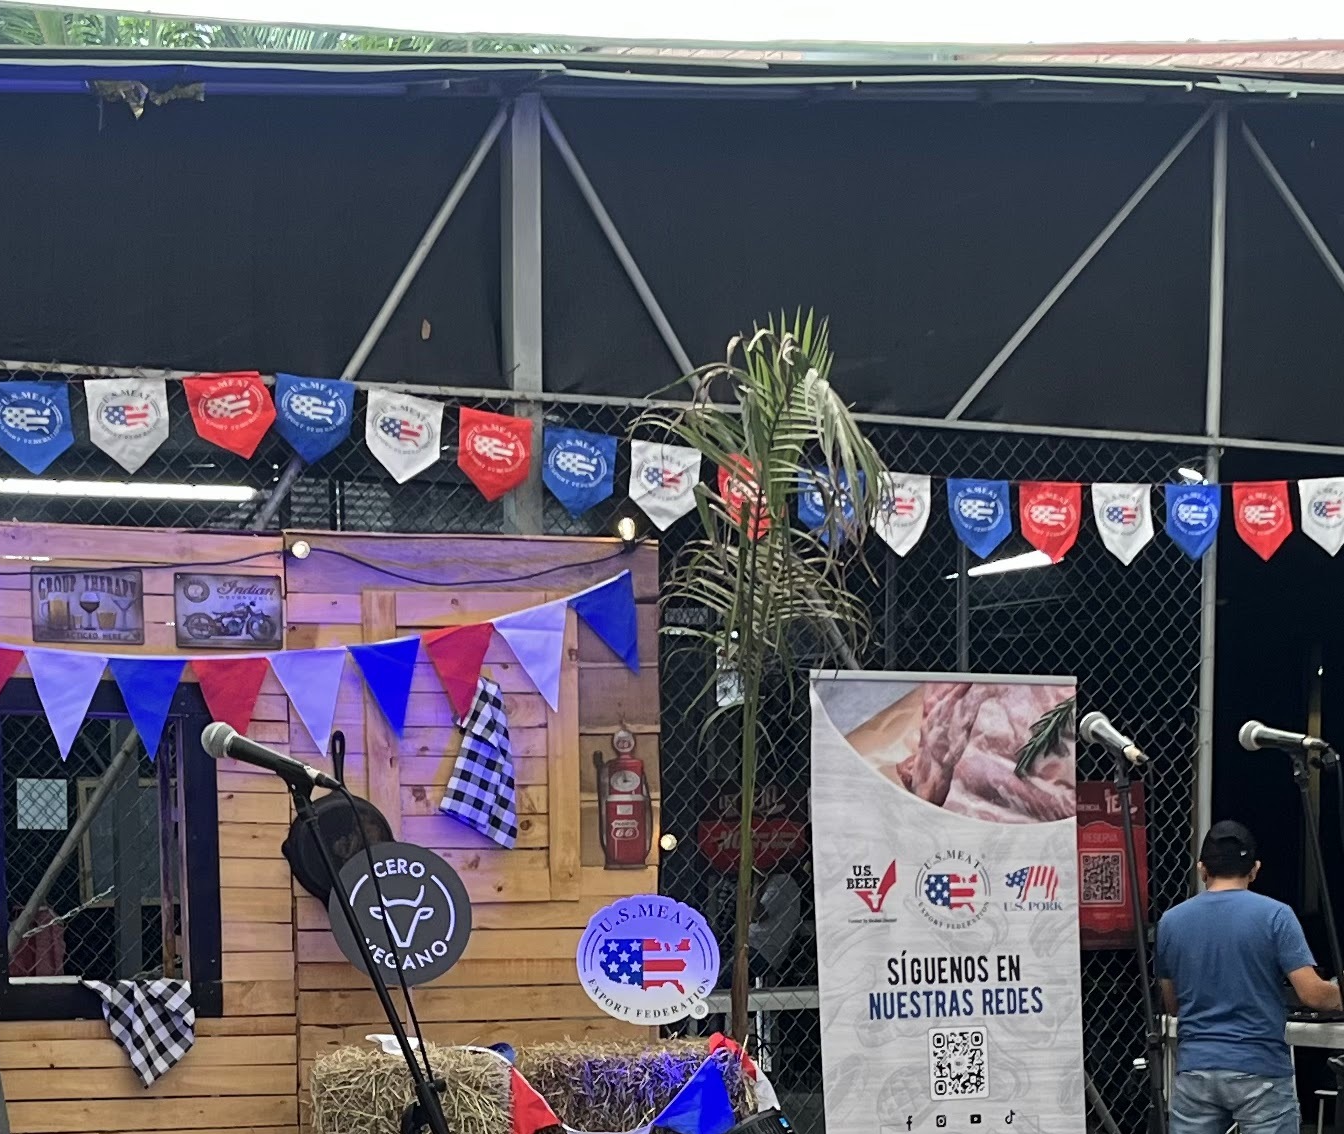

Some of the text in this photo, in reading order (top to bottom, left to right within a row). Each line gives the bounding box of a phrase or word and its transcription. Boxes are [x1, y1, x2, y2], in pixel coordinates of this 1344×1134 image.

[38, 574, 138, 598] GROUP THERAPY
[216, 581, 276, 596] Indian
[373, 859, 425, 878] CERO
[846, 878, 880, 890] BEEF
[1028, 902, 1063, 911] PORK
[887, 950, 1021, 985] SÍGUENOS EN
[587, 977, 711, 1019] EXPORT FEDERATION
[868, 987, 1044, 1020] NUESTRAS REDES
